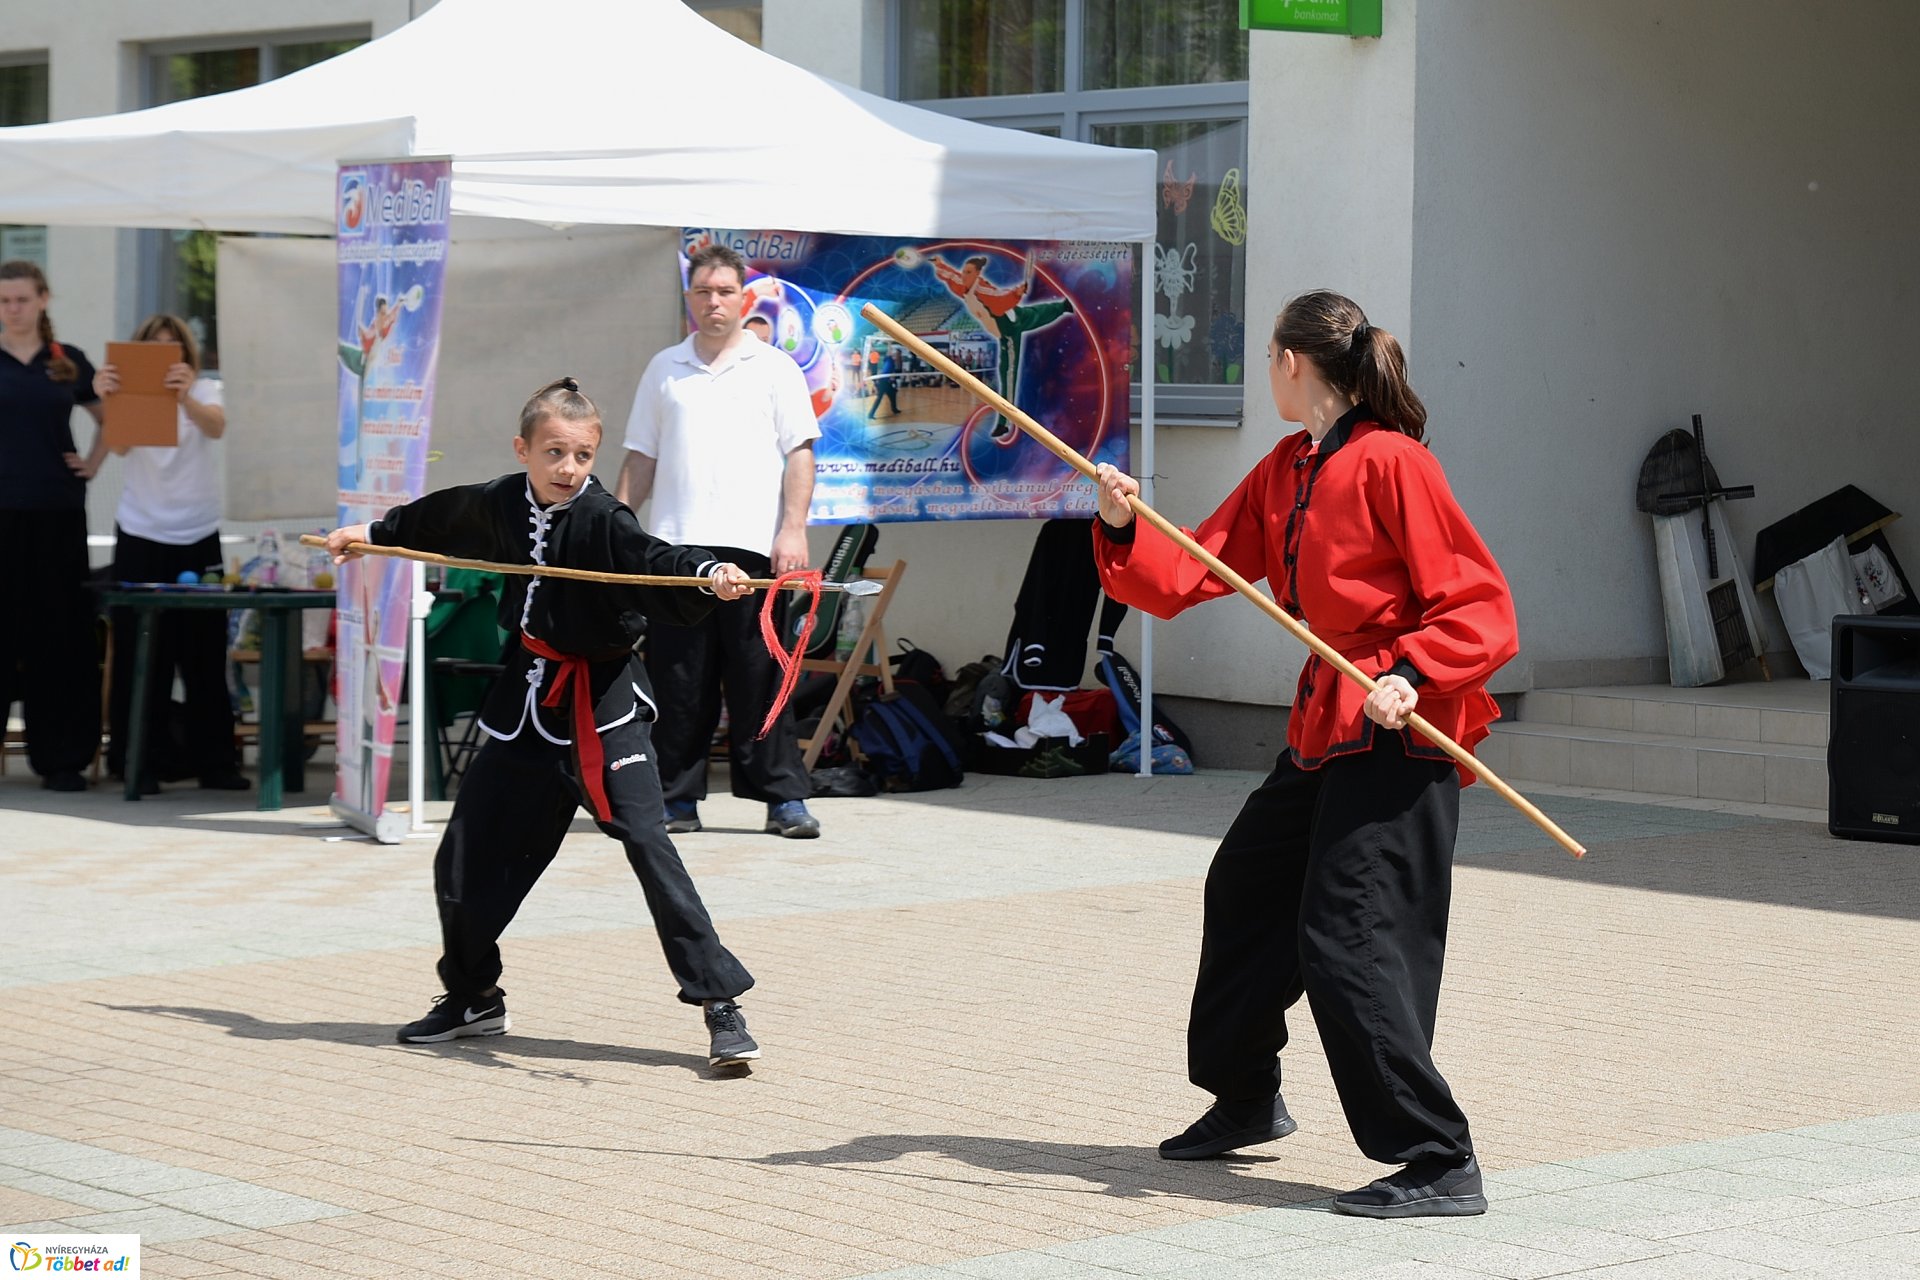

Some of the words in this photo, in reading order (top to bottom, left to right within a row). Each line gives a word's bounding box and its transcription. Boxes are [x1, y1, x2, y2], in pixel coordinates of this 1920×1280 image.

[1294, 8, 1339, 22] bankomat
[366, 178, 448, 224] MediBall
[713, 231, 810, 260] MediBall
[815, 457, 961, 474] www.mediball.hu
